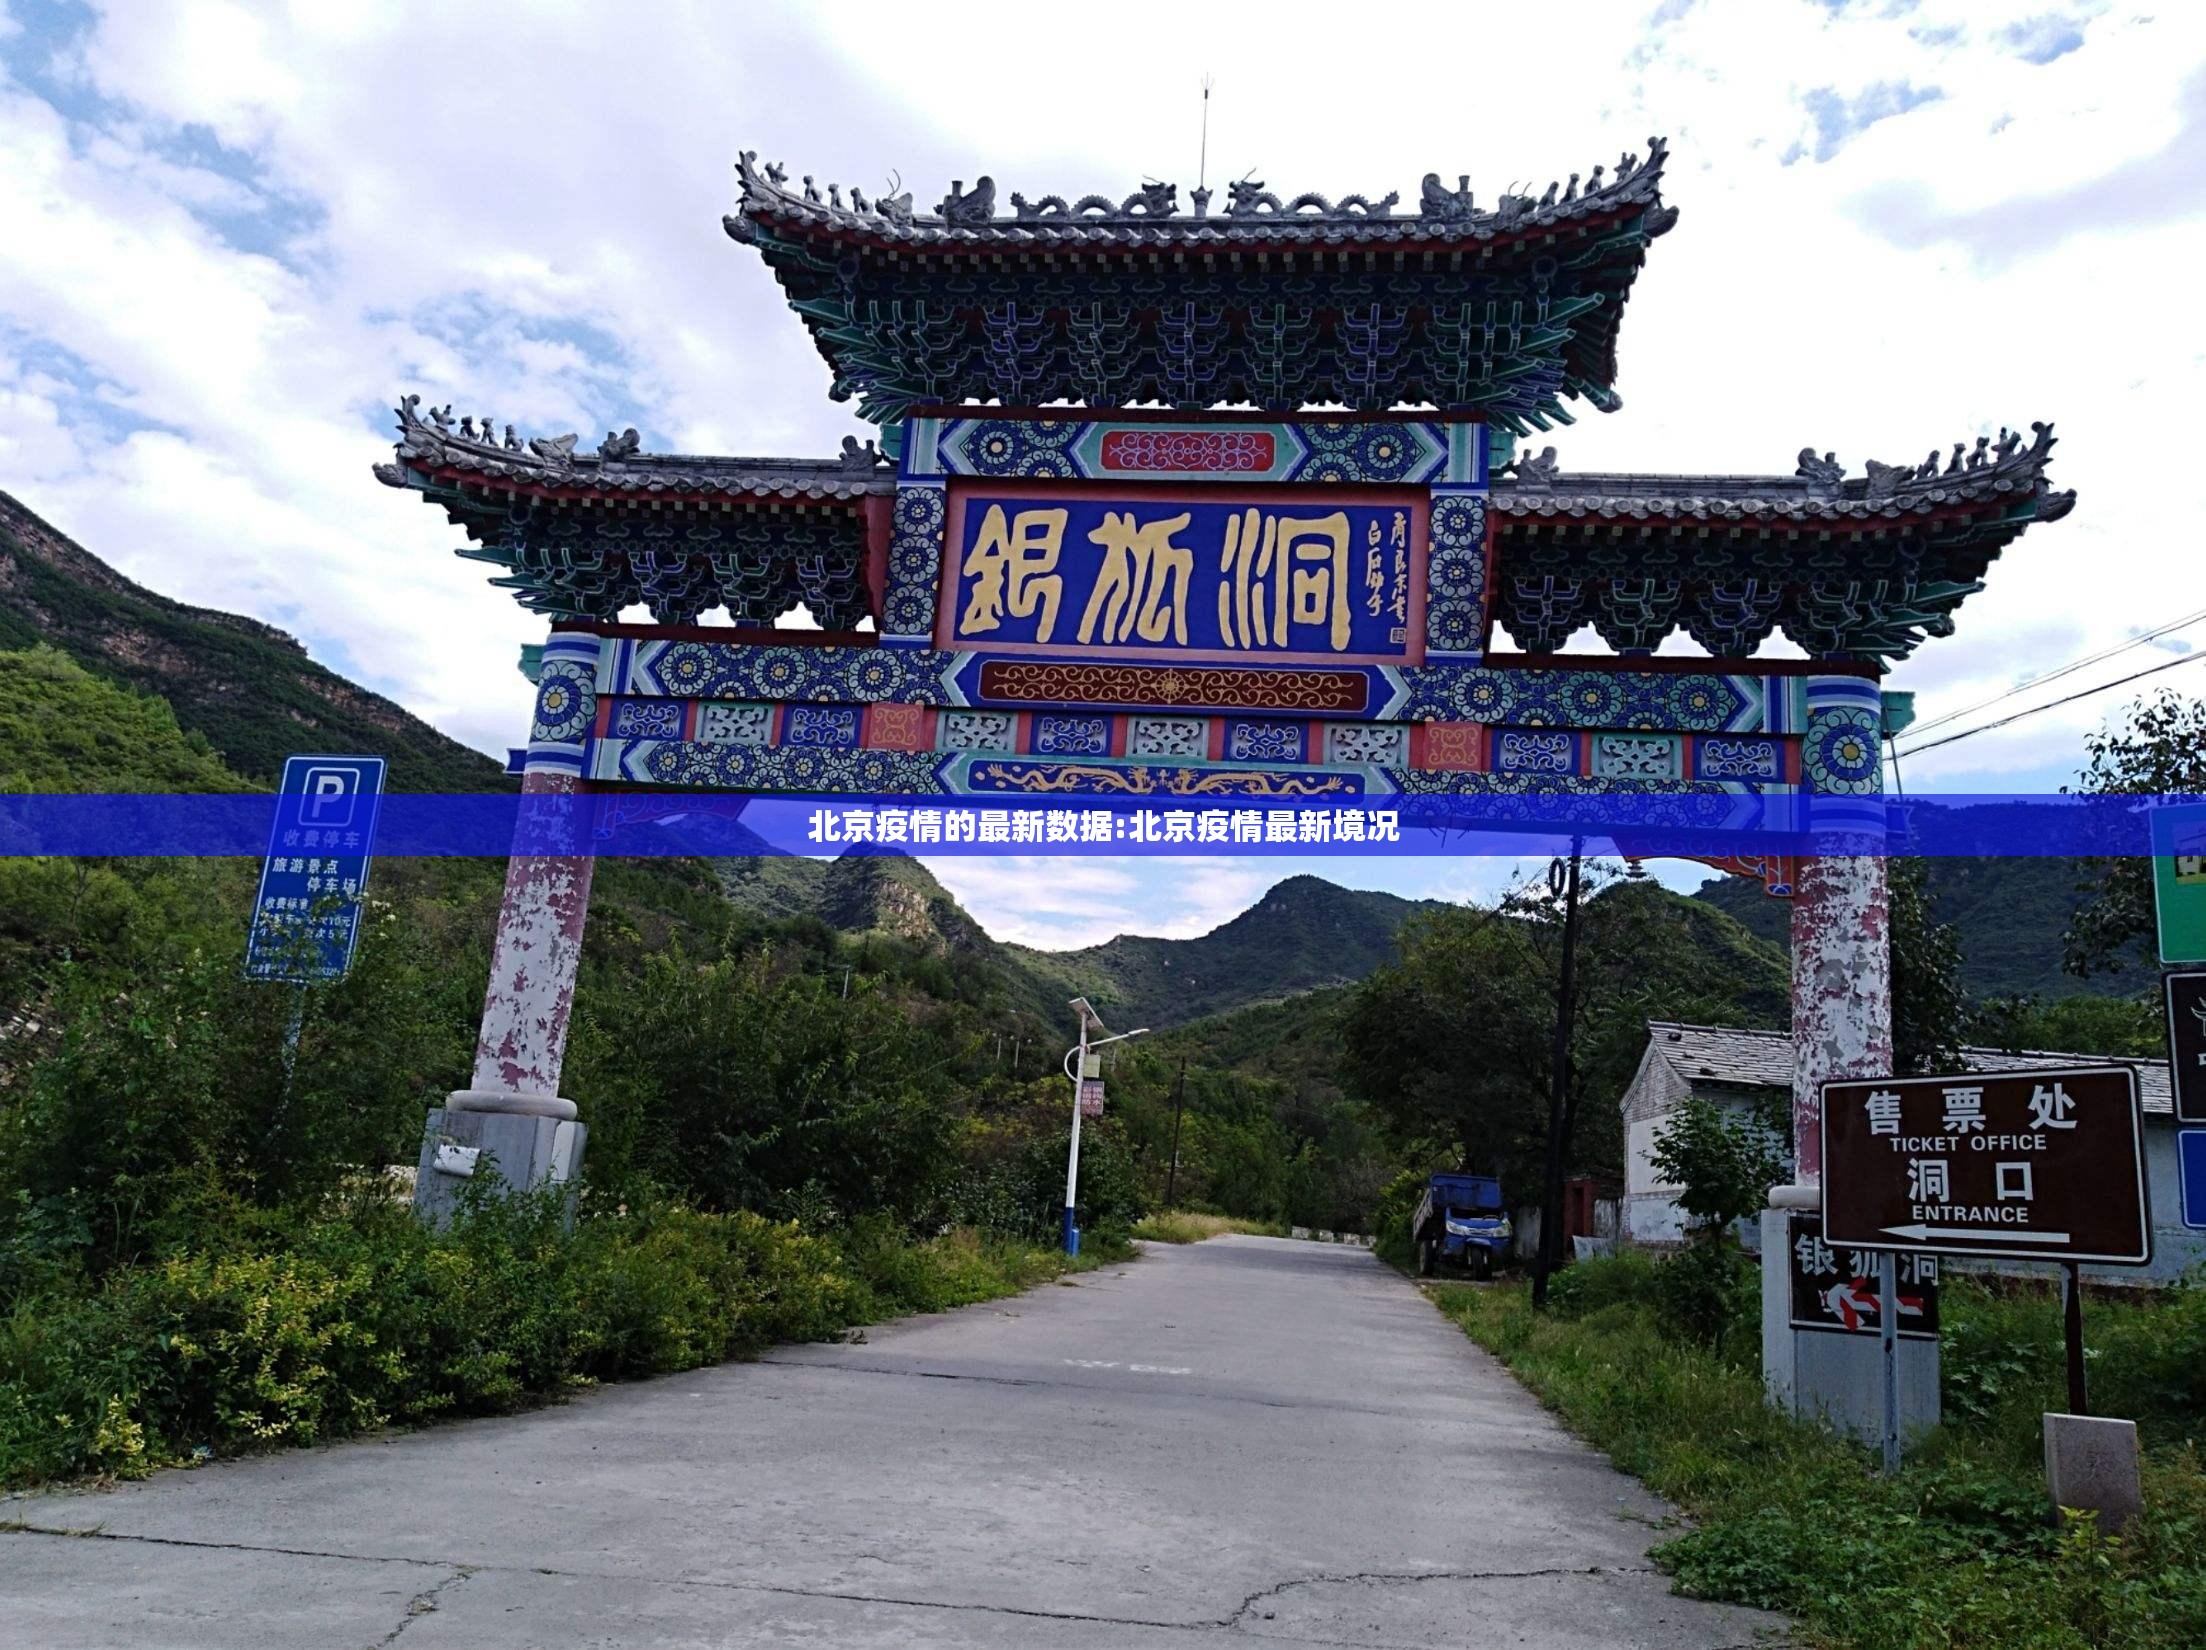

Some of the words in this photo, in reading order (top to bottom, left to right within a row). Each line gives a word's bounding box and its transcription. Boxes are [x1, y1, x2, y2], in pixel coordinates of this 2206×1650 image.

[311, 775, 345, 818] P
[283, 828, 360, 849] 收费停车
[272, 856, 339, 874] 旅游景点
[307, 876, 357, 894] 停车场
[1864, 1083, 2077, 1135] 售票处
[1889, 1136, 1960, 1153] TICKET
[1970, 1134, 2047, 1152] OFFICE
[1907, 1157, 2034, 1204] 洞口
[1912, 1205, 2029, 1224] ENTRANCE
